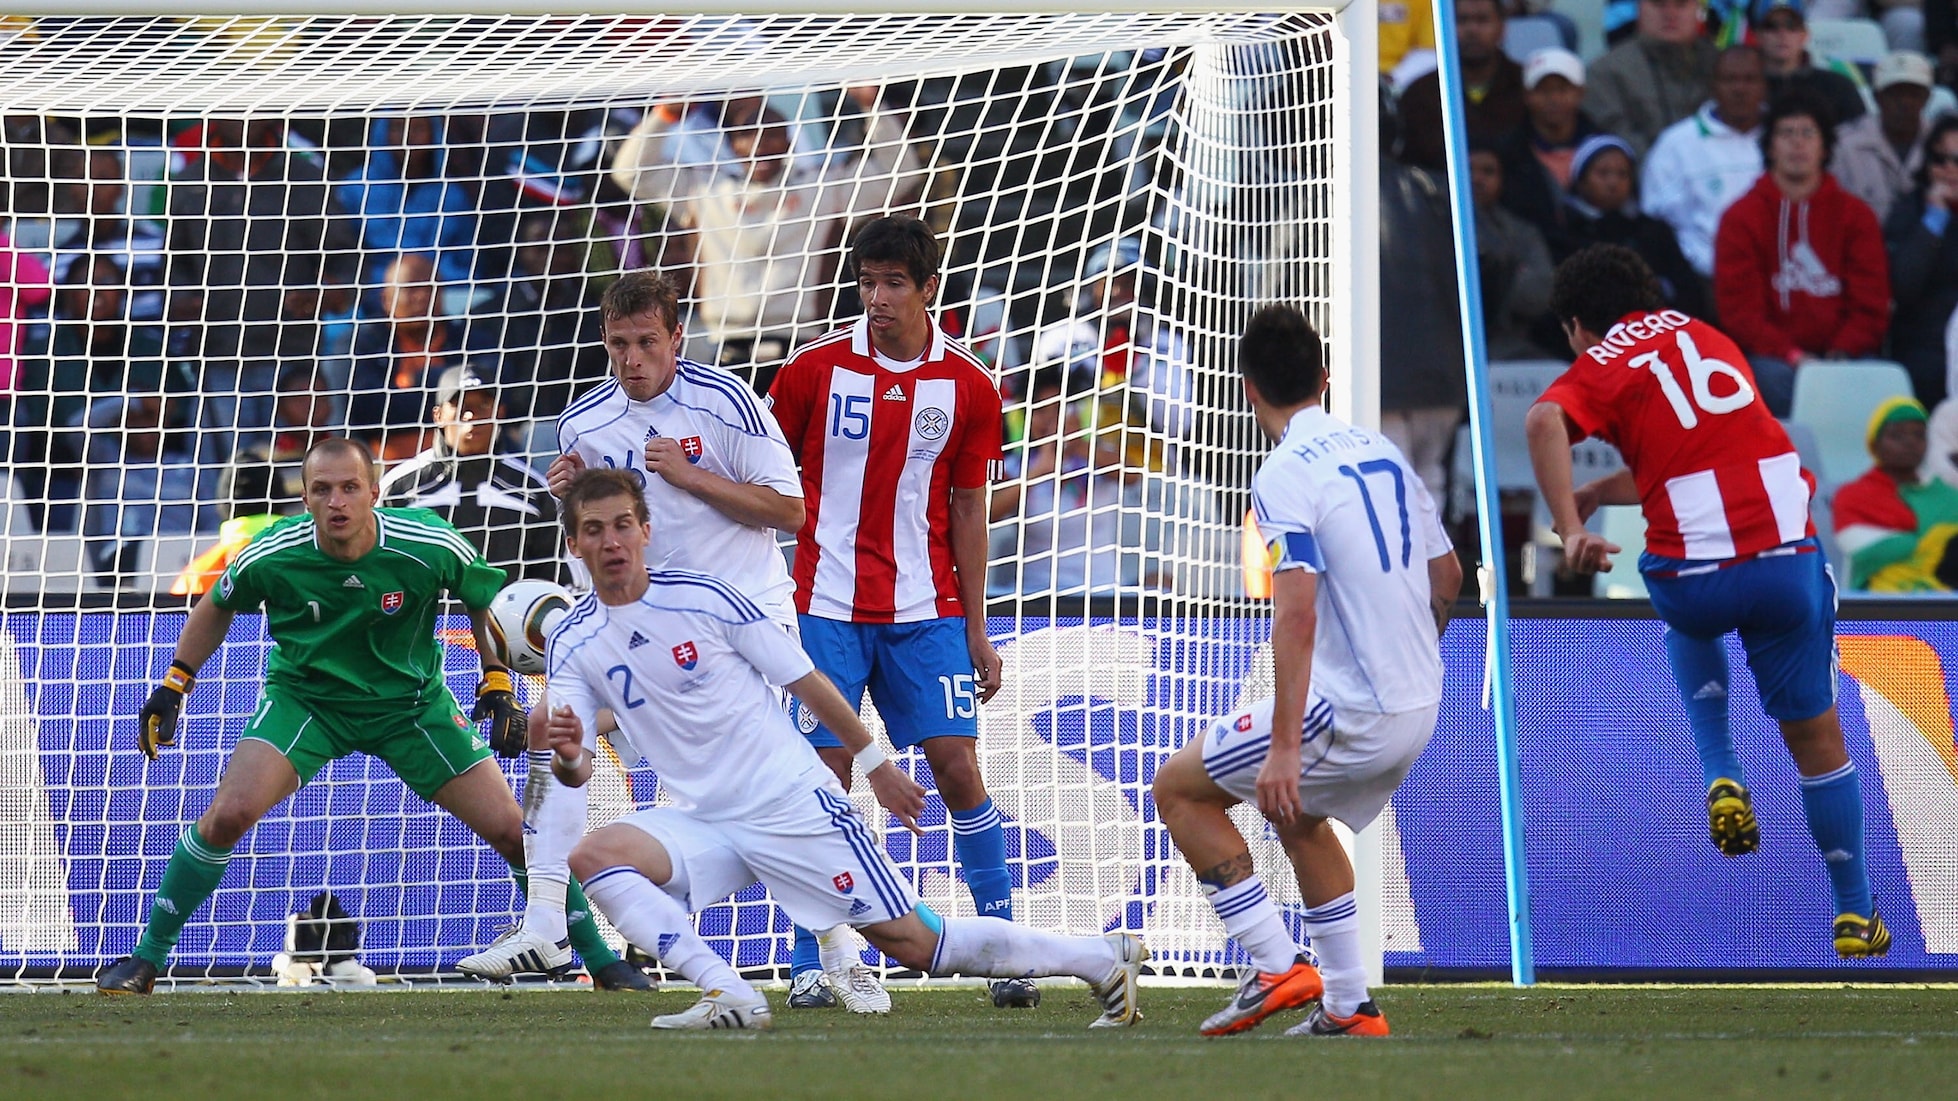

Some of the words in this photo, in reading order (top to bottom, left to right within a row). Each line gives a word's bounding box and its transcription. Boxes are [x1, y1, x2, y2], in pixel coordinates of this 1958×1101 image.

[1586, 310, 1691, 365] RIVERO
[882, 394, 907, 402] adidas
[1628, 330, 1756, 430] 16
[832, 393, 870, 439] 15
[1292, 428, 1385, 464] HAMS
[1338, 458, 1412, 574] 17
[307, 601, 320, 622] 1
[606, 664, 646, 709] 2
[938, 674, 975, 719] 15
[984, 898, 1010, 912] APF
